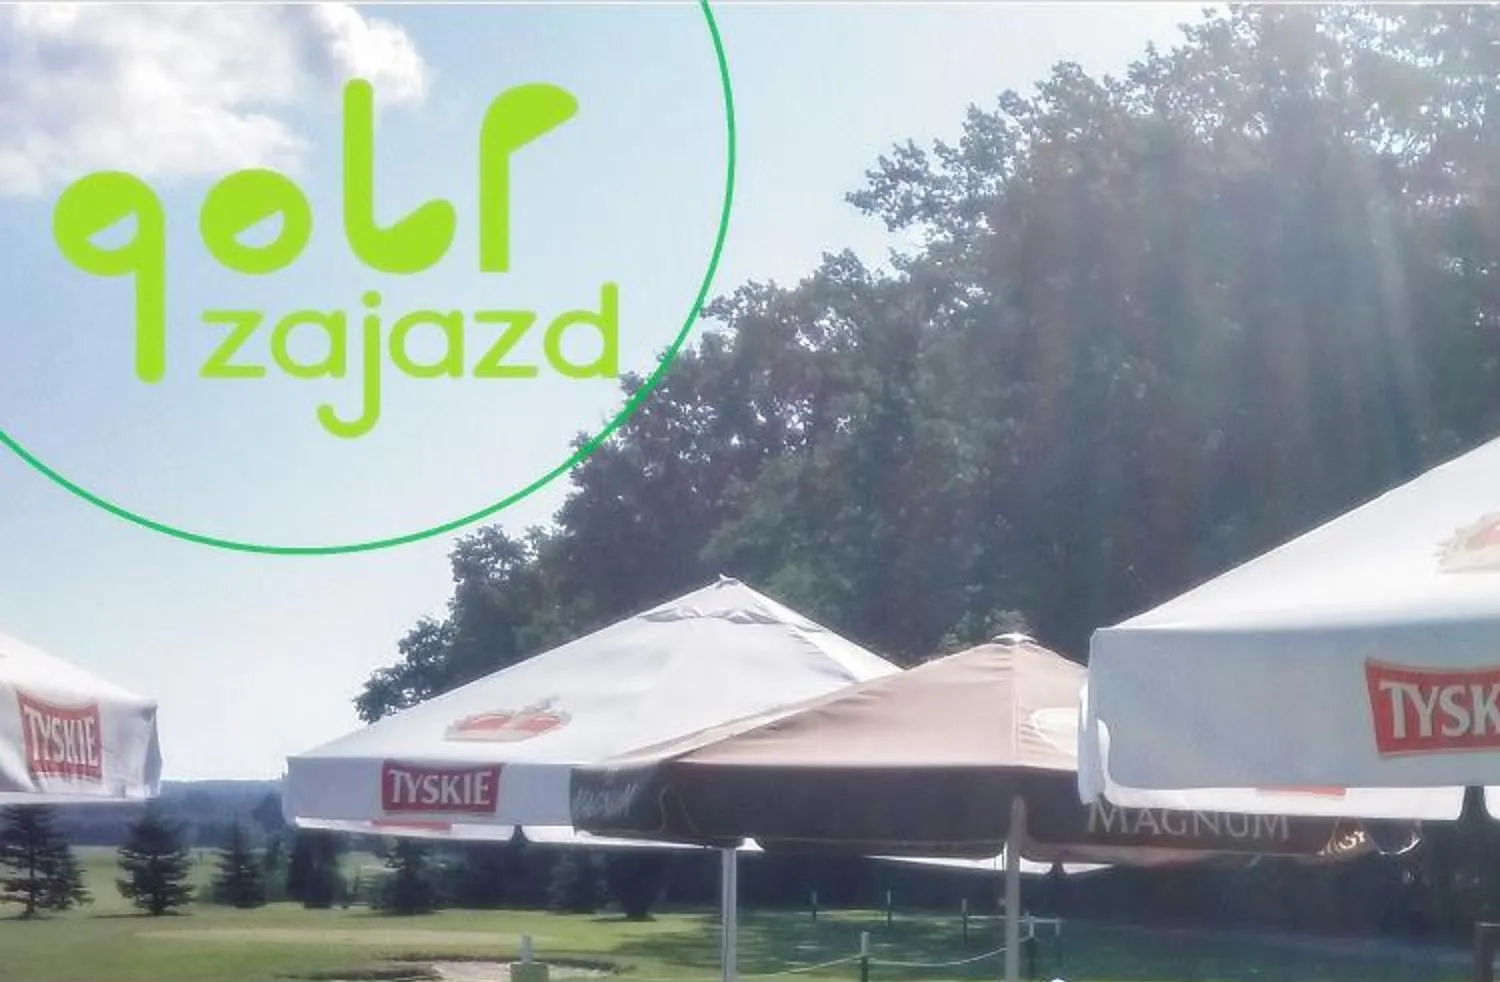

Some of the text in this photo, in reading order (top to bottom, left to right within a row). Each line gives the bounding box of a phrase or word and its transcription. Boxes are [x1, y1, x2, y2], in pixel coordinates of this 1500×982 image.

[23, 703, 99, 767] TYSKIE
[387, 768, 492, 806] TYSKIE
[1086, 801, 1291, 841] MAGNUM
